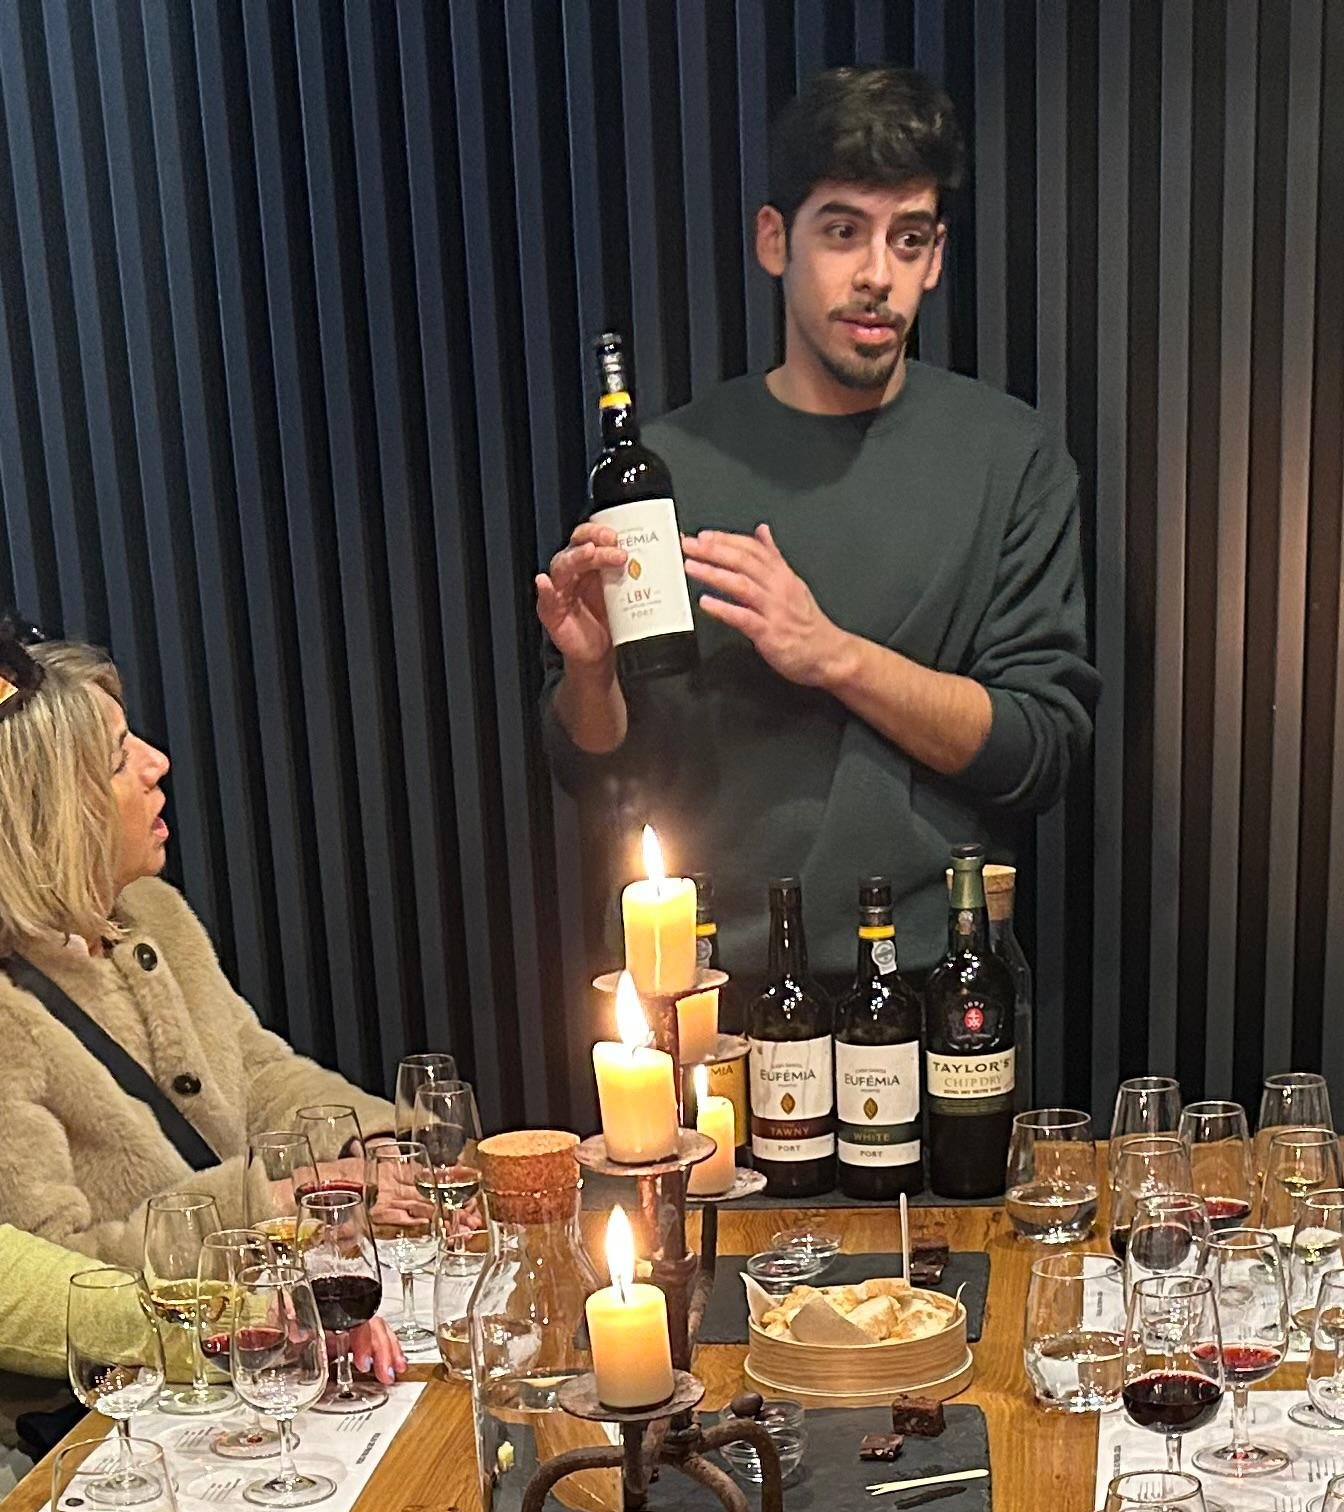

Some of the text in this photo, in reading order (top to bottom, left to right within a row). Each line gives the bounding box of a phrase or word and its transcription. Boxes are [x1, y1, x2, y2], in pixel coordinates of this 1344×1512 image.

[618, 531, 659, 547] FÉMIA
[626, 588, 651, 603] LBV
[631, 608, 654, 619] PORT
[932, 1058, 1011, 1074] TAYLOR'S
[944, 1075, 1002, 1088] CHIP DRY
[770, 1126, 811, 1137] TAWNY
[853, 1132, 891, 1143] WHITE
[778, 1144, 802, 1152] PORT
[860, 1150, 883, 1158] PORT
